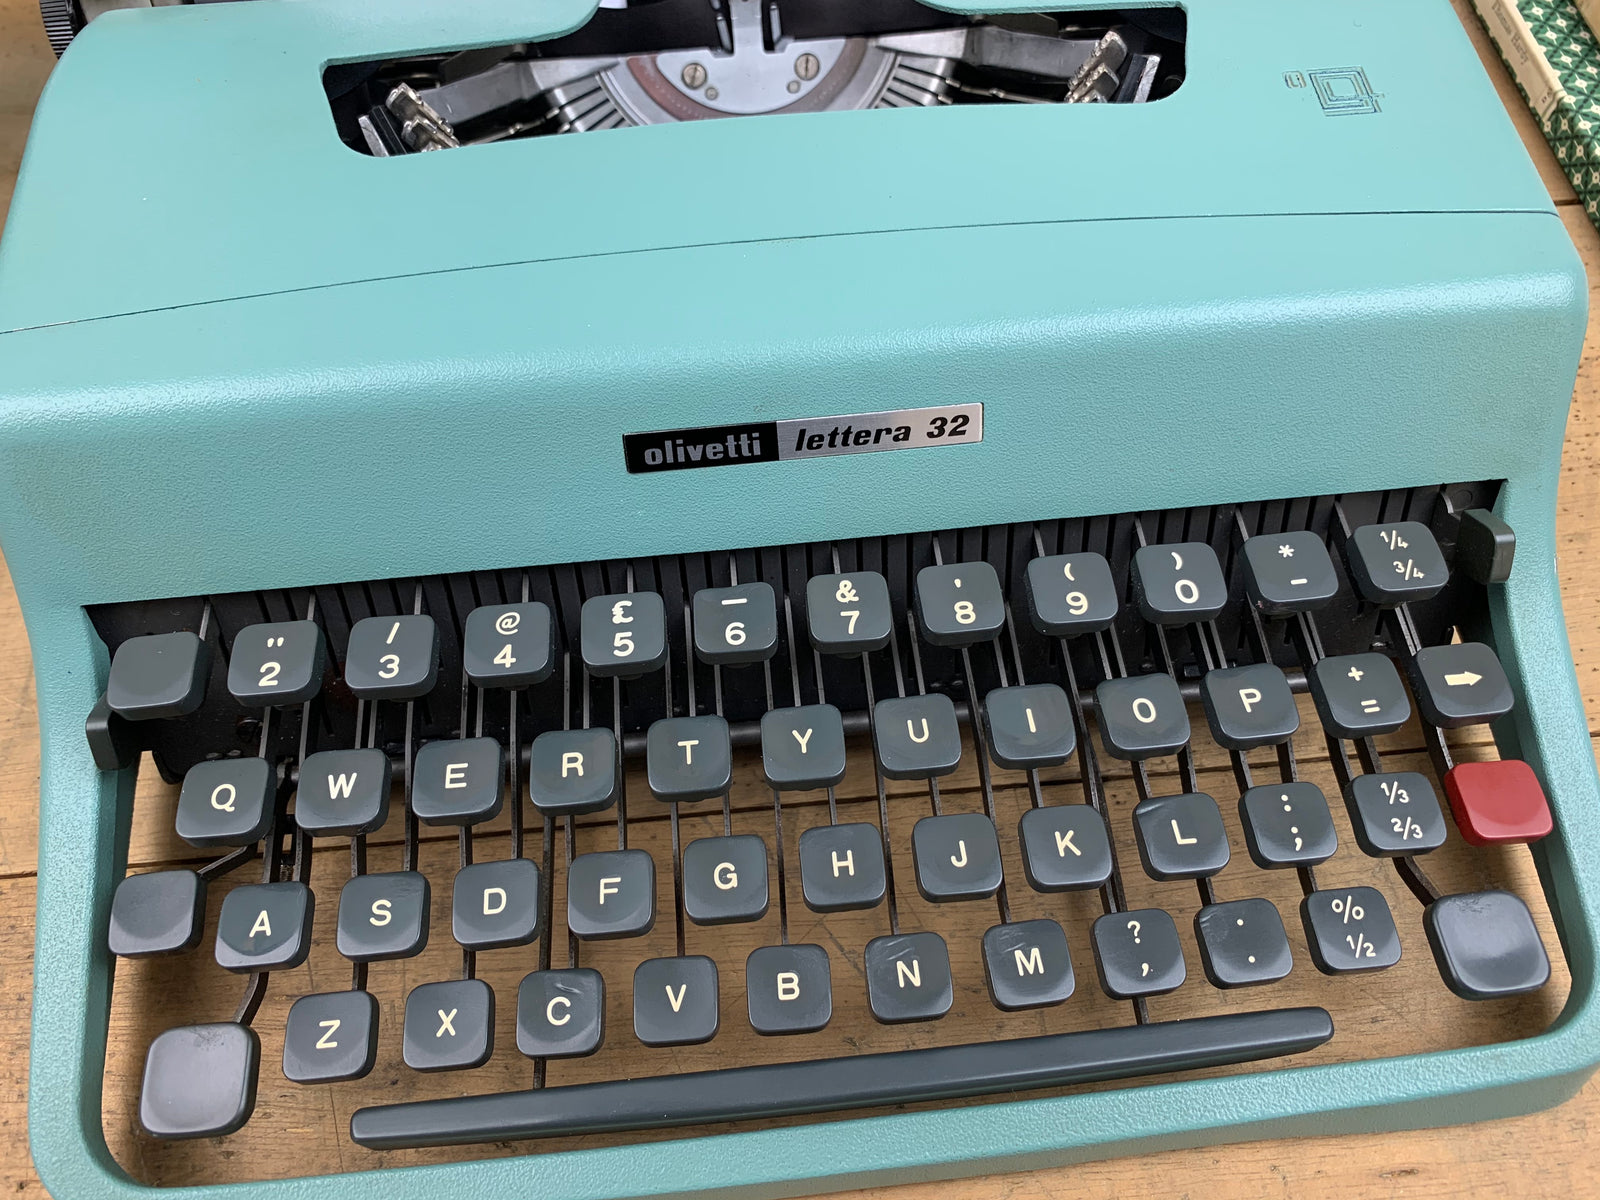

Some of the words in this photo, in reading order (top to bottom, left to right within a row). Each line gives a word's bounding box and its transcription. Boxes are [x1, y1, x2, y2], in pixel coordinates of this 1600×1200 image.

[795, 424, 912, 452] lettera
[926, 414, 970, 439] 32
[644, 432, 762, 466] olivetti
[835, 579, 860, 604] &
[1065, 591, 1089, 616] 9
[1174, 579, 1200, 604] 0
[495, 611, 521, 636] @
[611, 600, 634, 625] £
[839, 610, 860, 635] 7
[953, 600, 977, 625] 8
[613, 631, 635, 657] 5
[724, 621, 747, 646] 6
[377, 653, 400, 679] 3
[493, 643, 517, 669] 4
[257, 661, 281, 687] 2
[1132, 697, 1157, 724] O
[1238, 687, 1262, 713] P
[791, 728, 813, 754] Y
[906, 717, 930, 744] U
[561, 751, 584, 778] R
[677, 739, 700, 765] T
[327, 772, 358, 800] W
[444, 762, 469, 789] E
[210, 783, 237, 813] Q
[1054, 829, 1082, 858] K
[1170, 819, 1198, 845] L
[831, 849, 855, 878] H
[950, 840, 968, 868] J
[713, 862, 738, 890] G
[483, 887, 507, 916] D
[599, 876, 622, 905] F
[369, 899, 392, 927] S
[1331, 895, 1365, 924] %
[248, 909, 272, 938] A
[1127, 920, 1141, 944] ?
[896, 959, 921, 988] N
[1014, 947, 1045, 977] M
[665, 983, 687, 1013] V
[776, 972, 800, 1001] B
[435, 1008, 458, 1038] X
[546, 996, 572, 1026] C
[315, 1019, 341, 1050] Z
